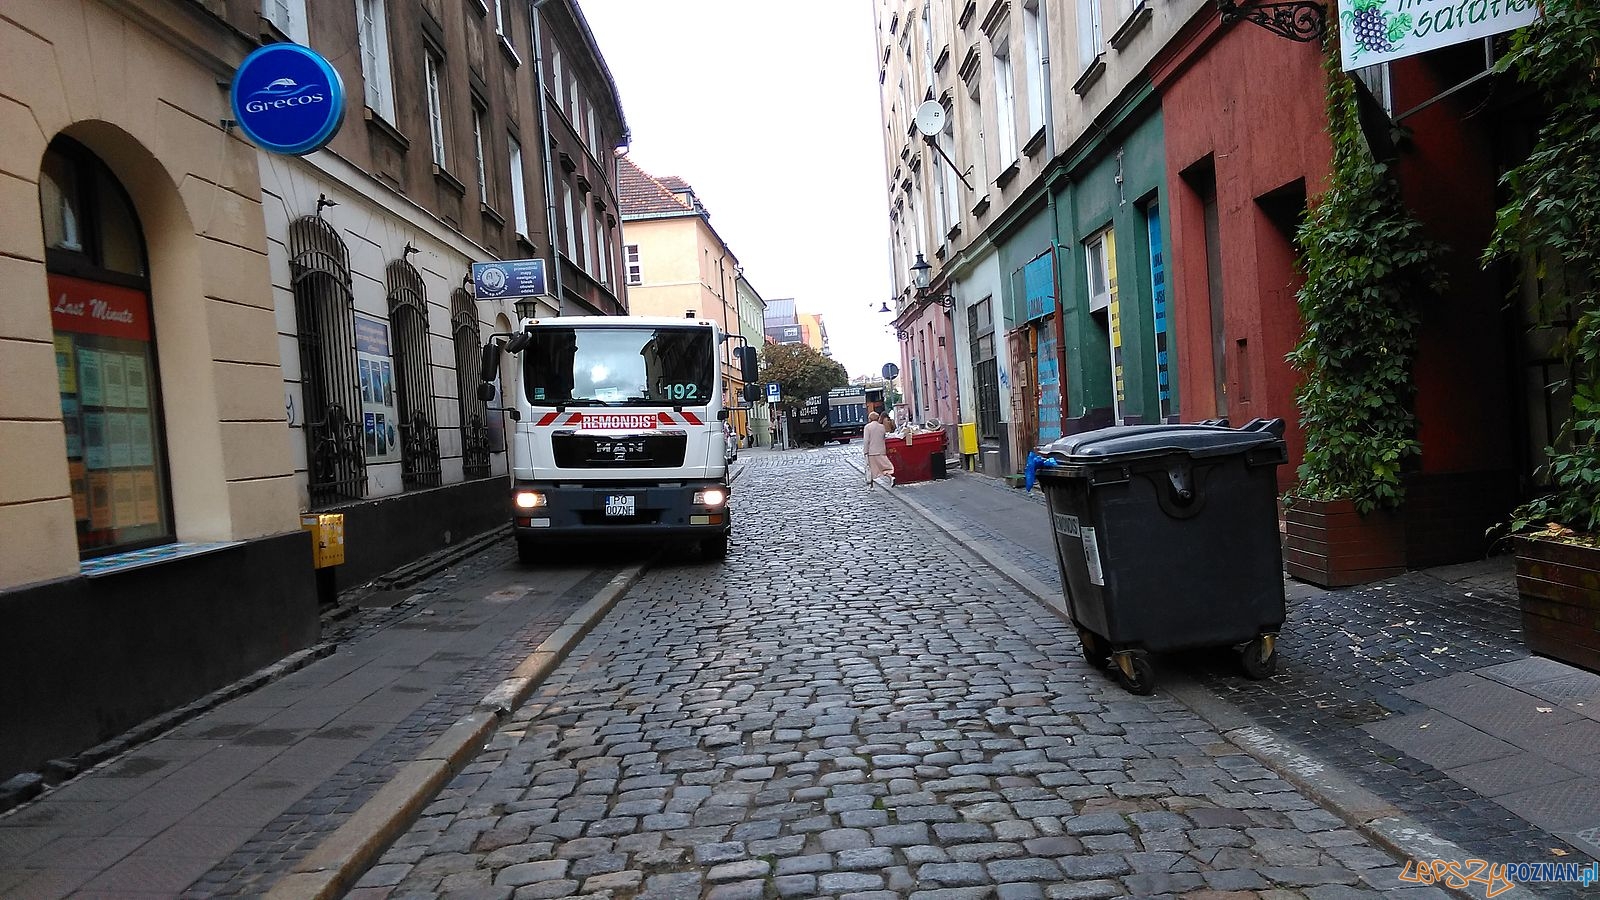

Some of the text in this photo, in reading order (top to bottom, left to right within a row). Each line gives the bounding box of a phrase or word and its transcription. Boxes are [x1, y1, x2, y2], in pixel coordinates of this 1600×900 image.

[246, 93, 324, 113] Grecos
[53, 293, 135, 324] Last Minute
[664, 384, 697, 400] 192
[613, 496, 628, 505] PO
